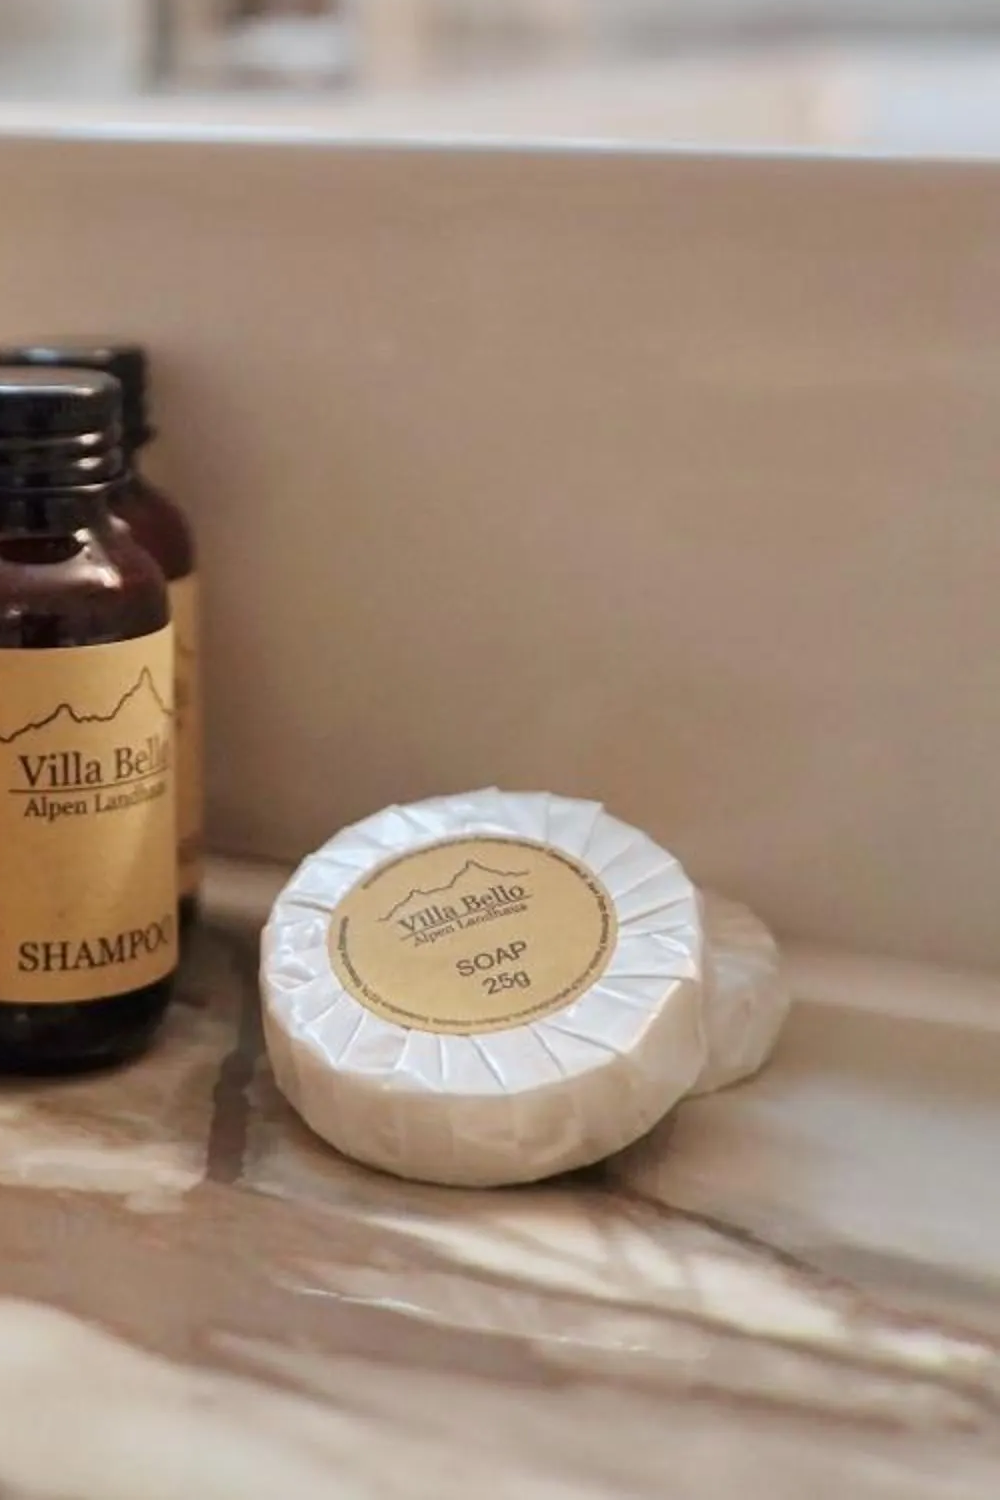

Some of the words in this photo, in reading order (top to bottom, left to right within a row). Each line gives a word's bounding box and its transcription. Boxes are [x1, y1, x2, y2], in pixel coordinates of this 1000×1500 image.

[18, 752, 103, 788] Villa
[24, 797, 87, 823] Alpen
[398, 904, 458, 931] Villa
[460, 885, 525, 912] Bello
[414, 927, 455, 947] Alpen
[456, 940, 527, 977] SOAP
